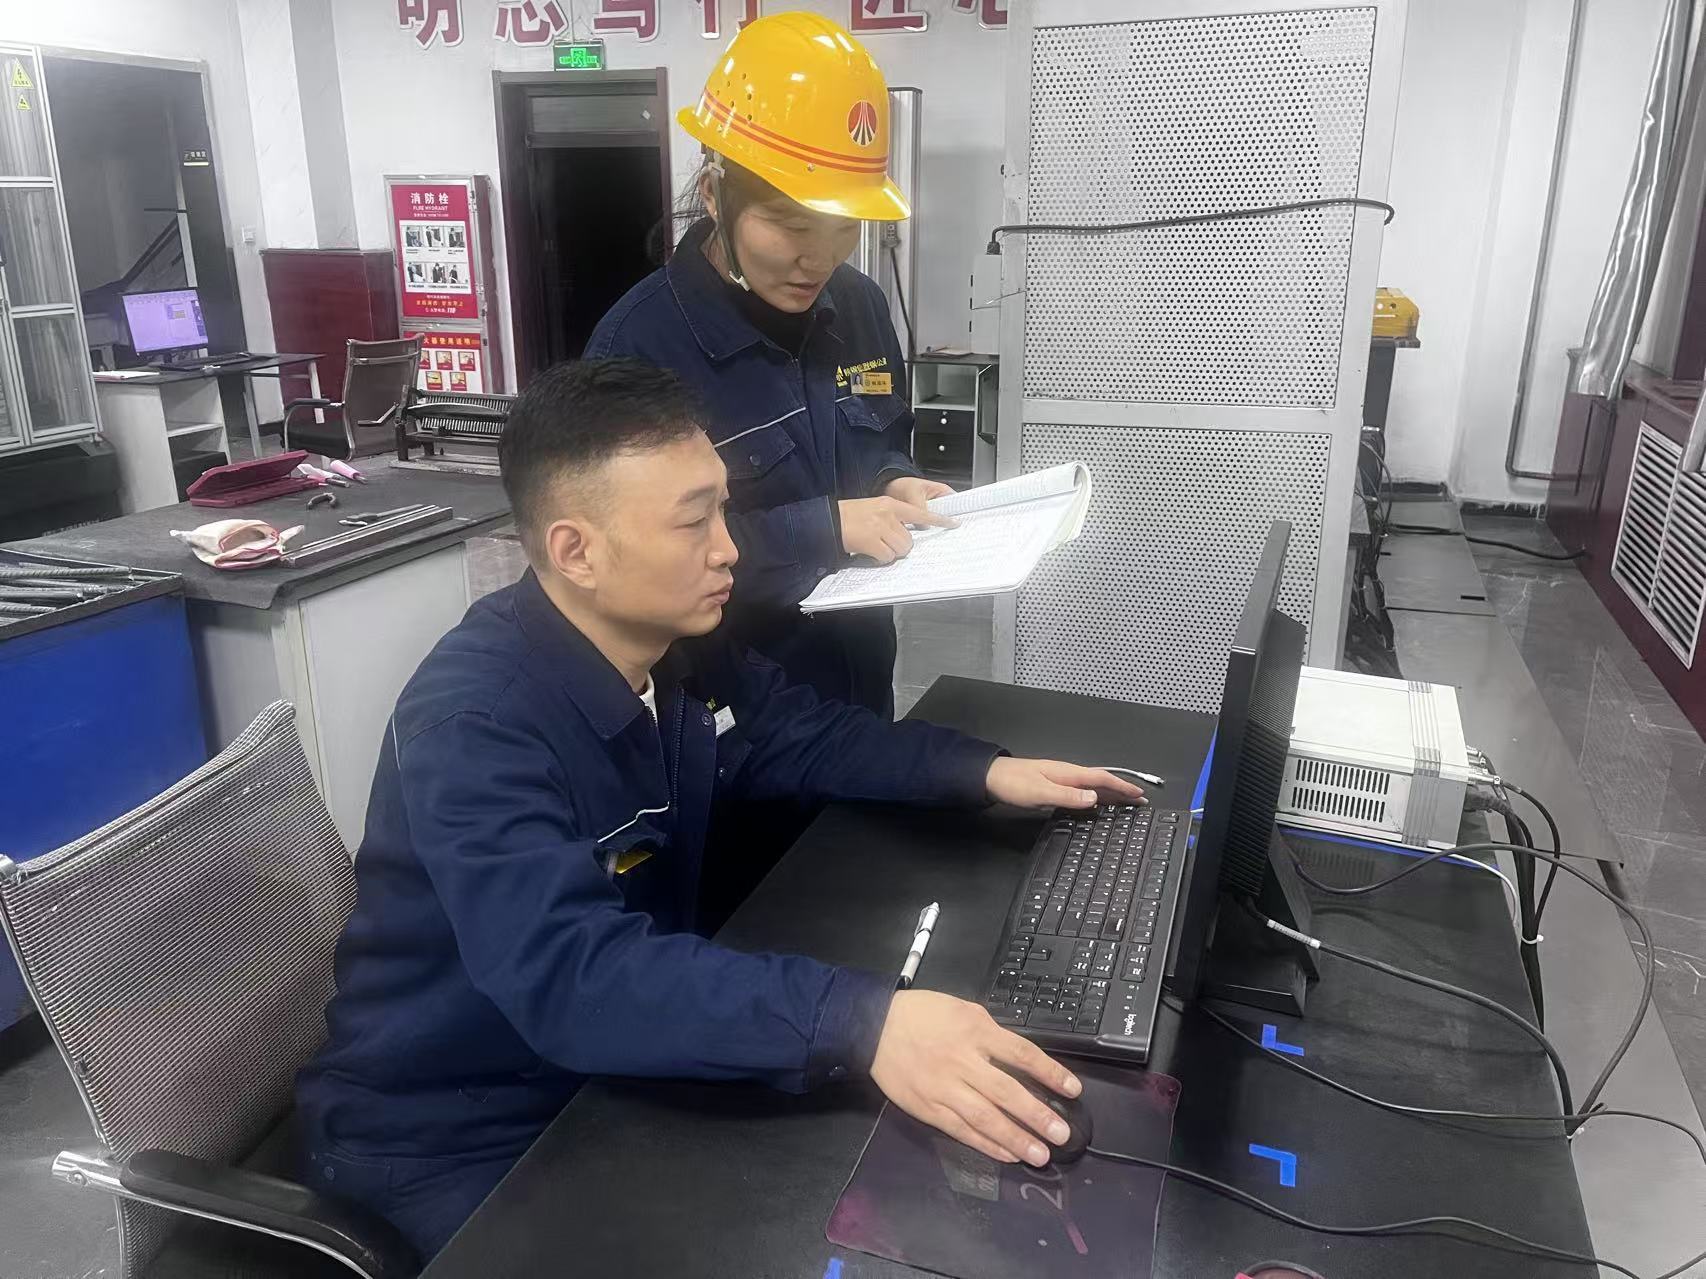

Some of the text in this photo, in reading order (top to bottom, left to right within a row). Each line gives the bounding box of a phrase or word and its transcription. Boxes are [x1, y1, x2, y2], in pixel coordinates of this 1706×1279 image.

[410, 192, 449, 205] 消防栓
[1124, 1013, 1137, 1036] logitech
